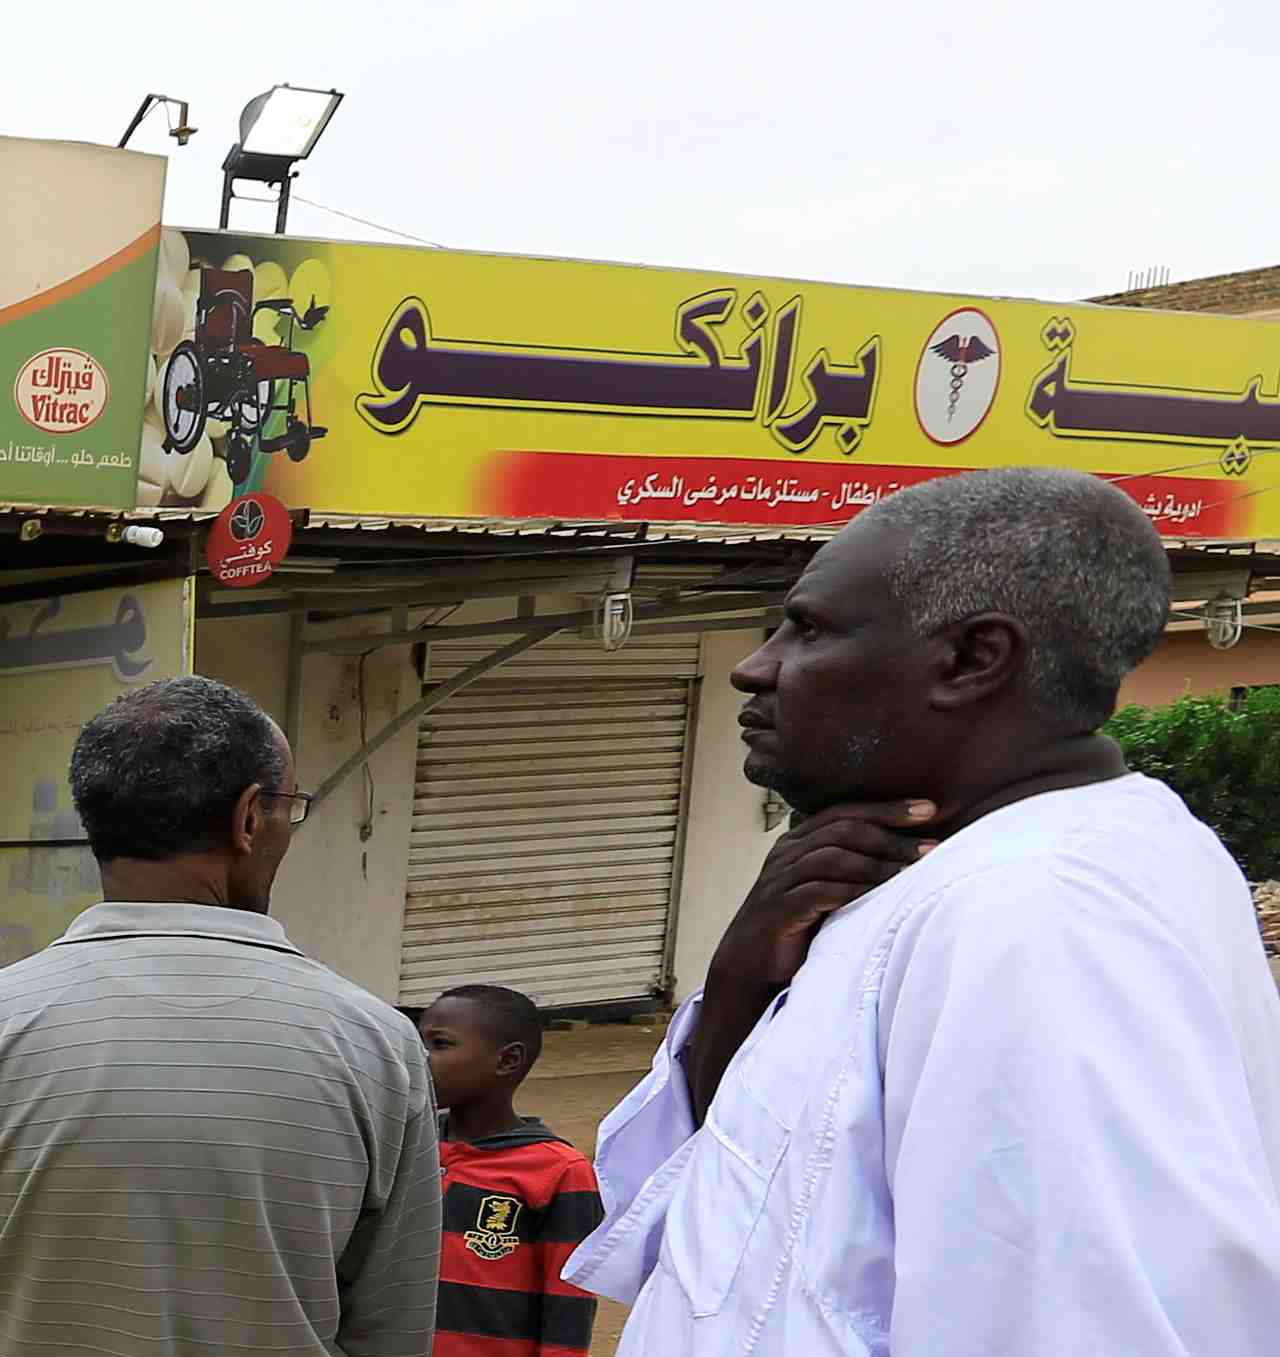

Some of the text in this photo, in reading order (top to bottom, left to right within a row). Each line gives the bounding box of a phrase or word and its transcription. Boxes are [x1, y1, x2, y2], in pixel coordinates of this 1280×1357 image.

[356, 289, 881, 453] برانكو
[31, 394, 90, 424] Vitrac
[15, 443, 55, 467] أوقاتنا
[71, 448, 94, 468] حلو
[96, 452, 132, 468] طعم
[617, 472, 684, 505] السكري
[683, 474, 738, 506] مرضى
[741, 477, 819, 507] مستلزمات
[220, 539, 272, 568] كوفتي
[220, 560, 272, 580] COFFTEA
